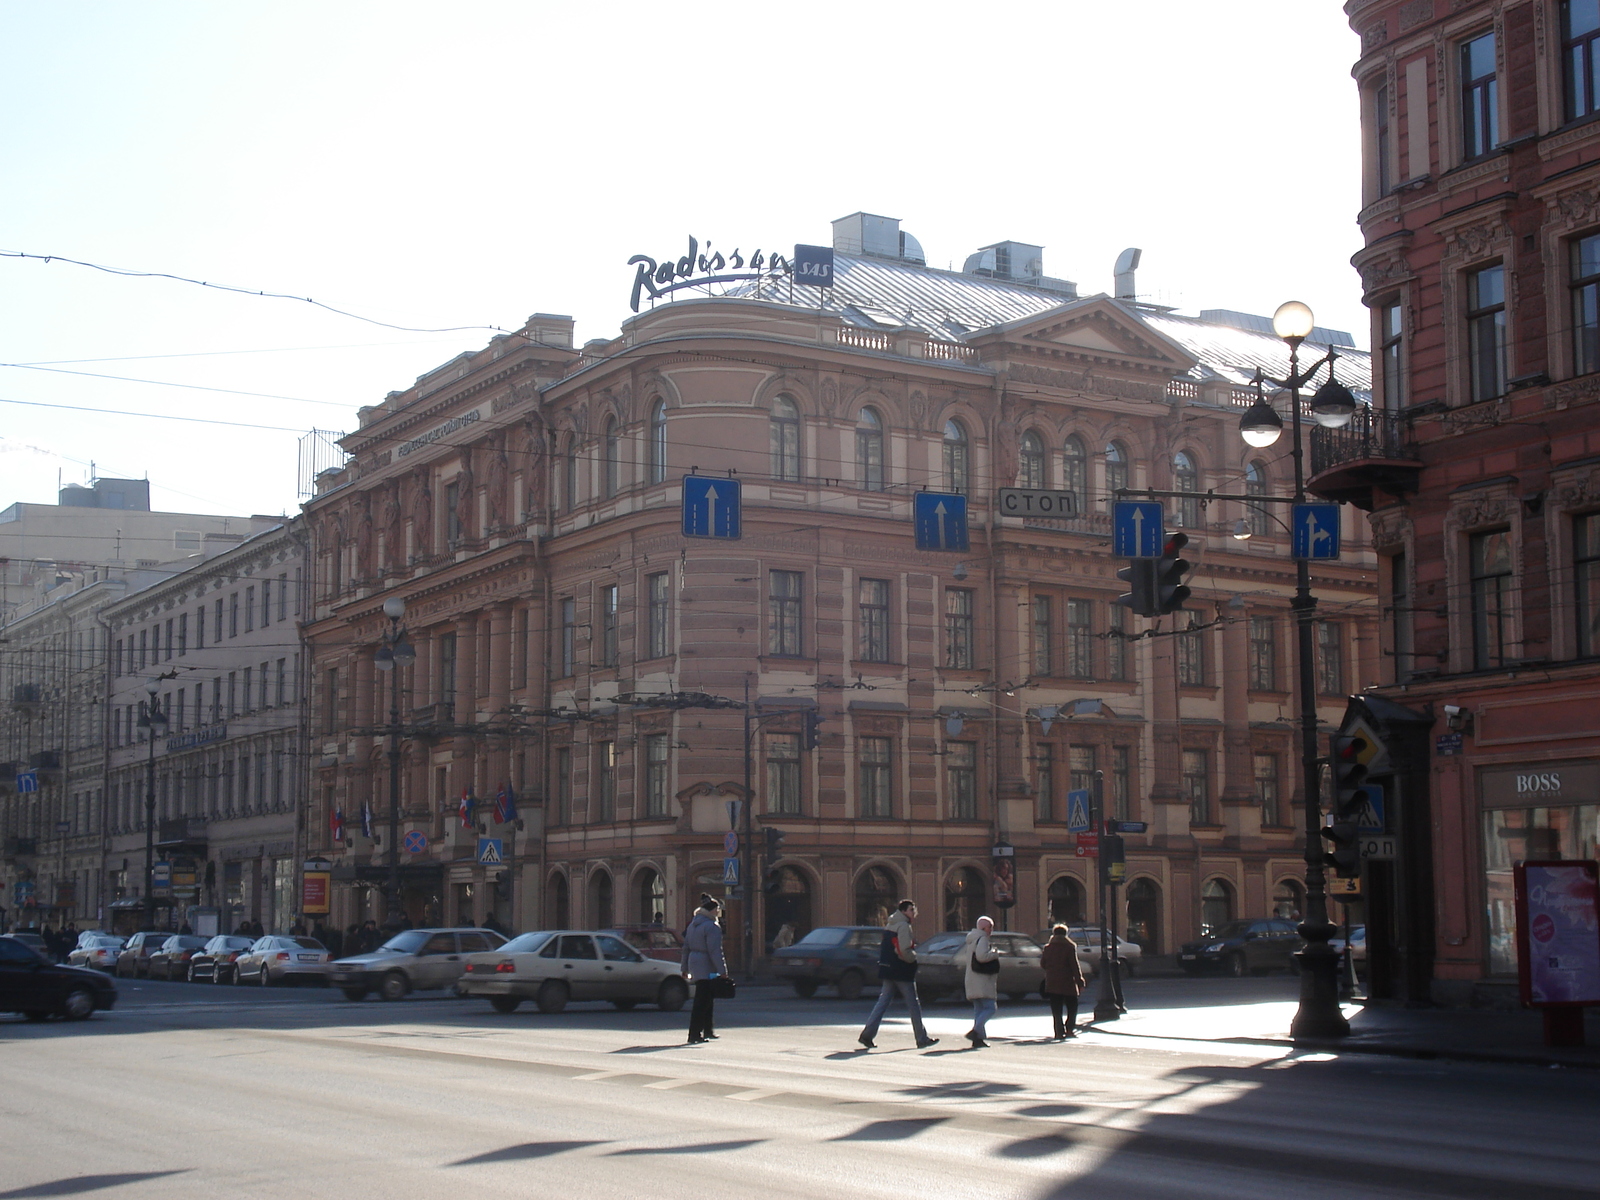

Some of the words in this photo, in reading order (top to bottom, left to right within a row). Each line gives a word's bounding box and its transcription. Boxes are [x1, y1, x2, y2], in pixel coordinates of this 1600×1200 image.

[627, 234, 793, 313] Radisson
[799, 261, 830, 278] SAS
[1005, 493, 1071, 512] СТОП
[1516, 772, 1561, 793] BOSS
